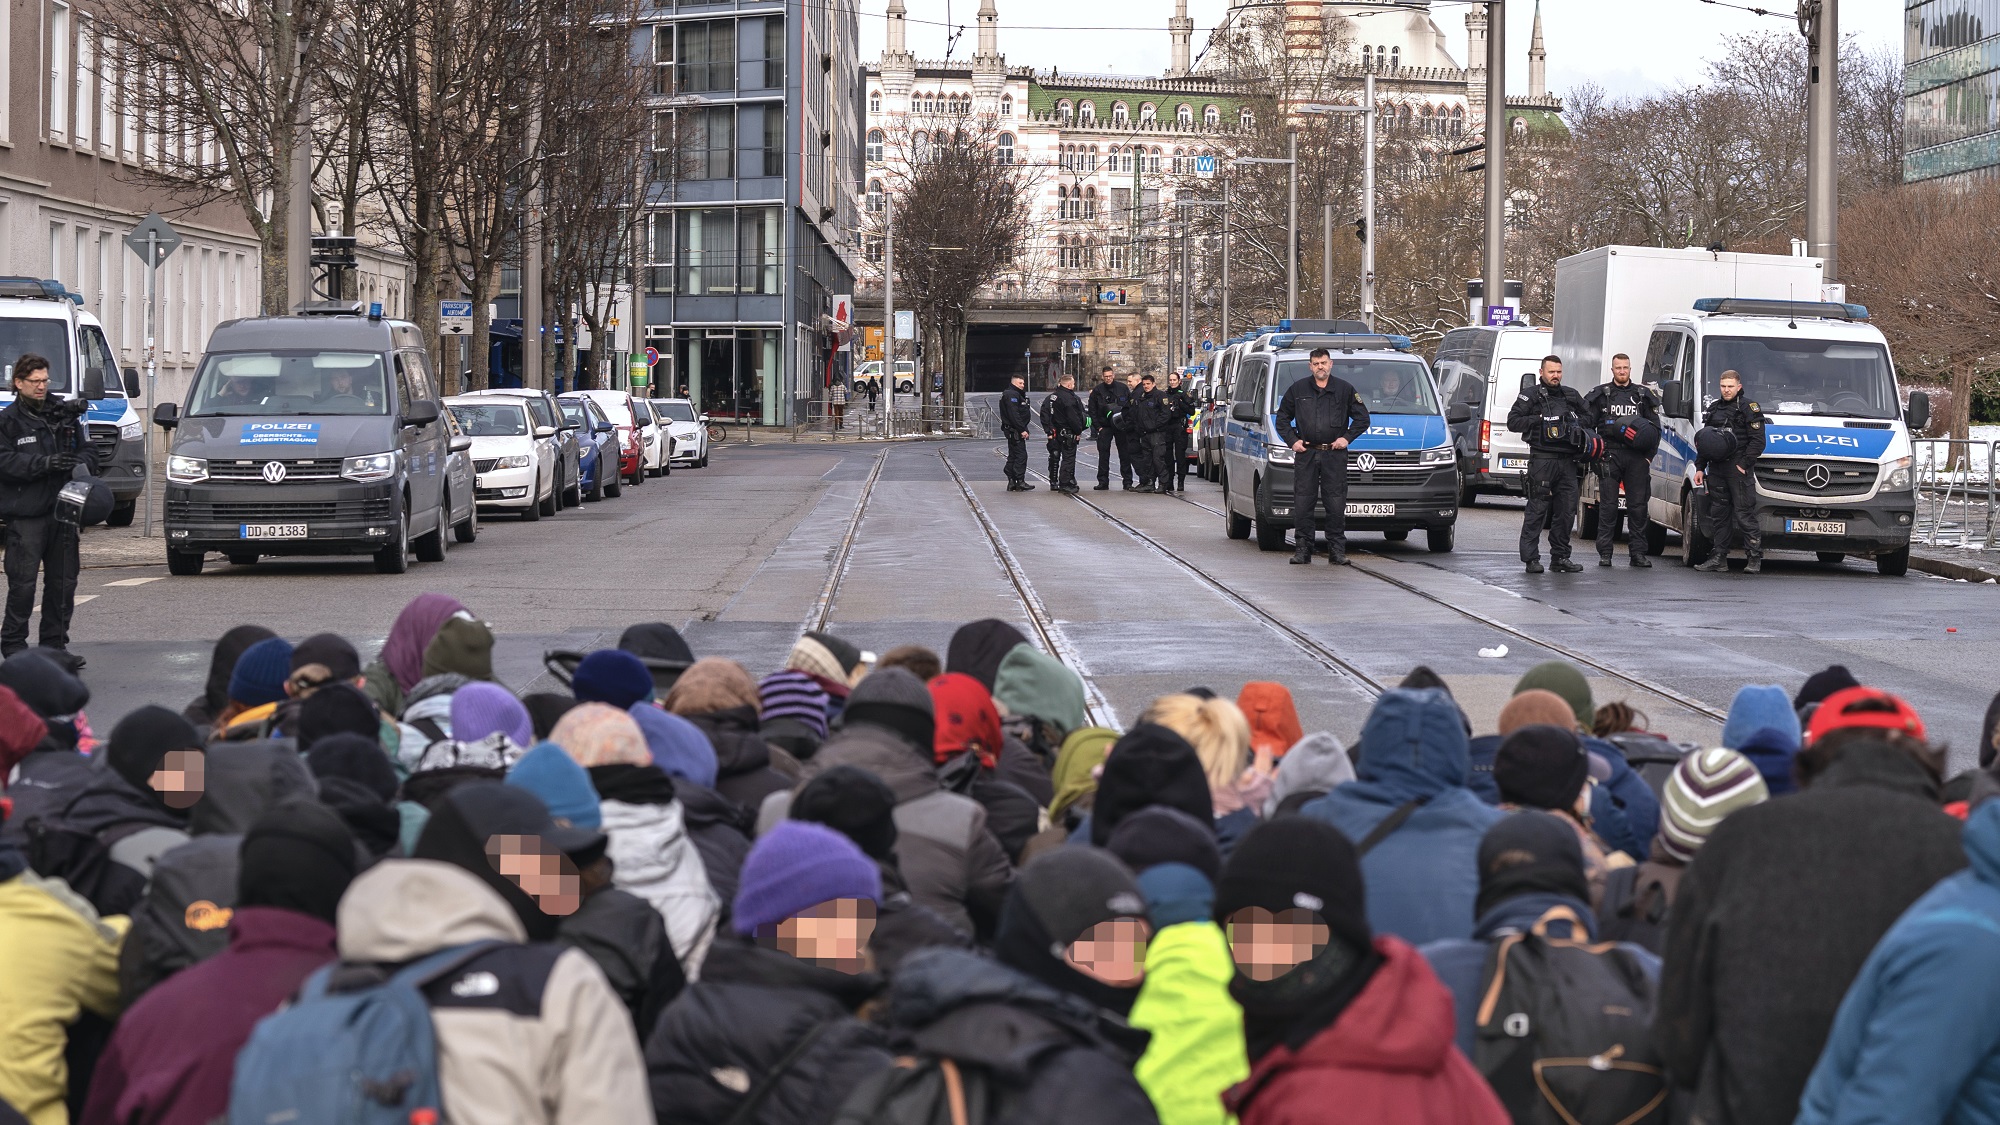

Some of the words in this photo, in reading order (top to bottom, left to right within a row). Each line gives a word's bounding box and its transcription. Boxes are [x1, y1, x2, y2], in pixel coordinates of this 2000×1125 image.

[1198, 158, 1213, 171] W
[1362, 426, 1405, 437] IZEI
[1769, 433, 1859, 448] POLIZEI
[247, 526, 262, 537] DD
[278, 525, 307, 537] 1383
[1792, 521, 1809, 532] LSA
[1817, 522, 1844, 534] 48351
